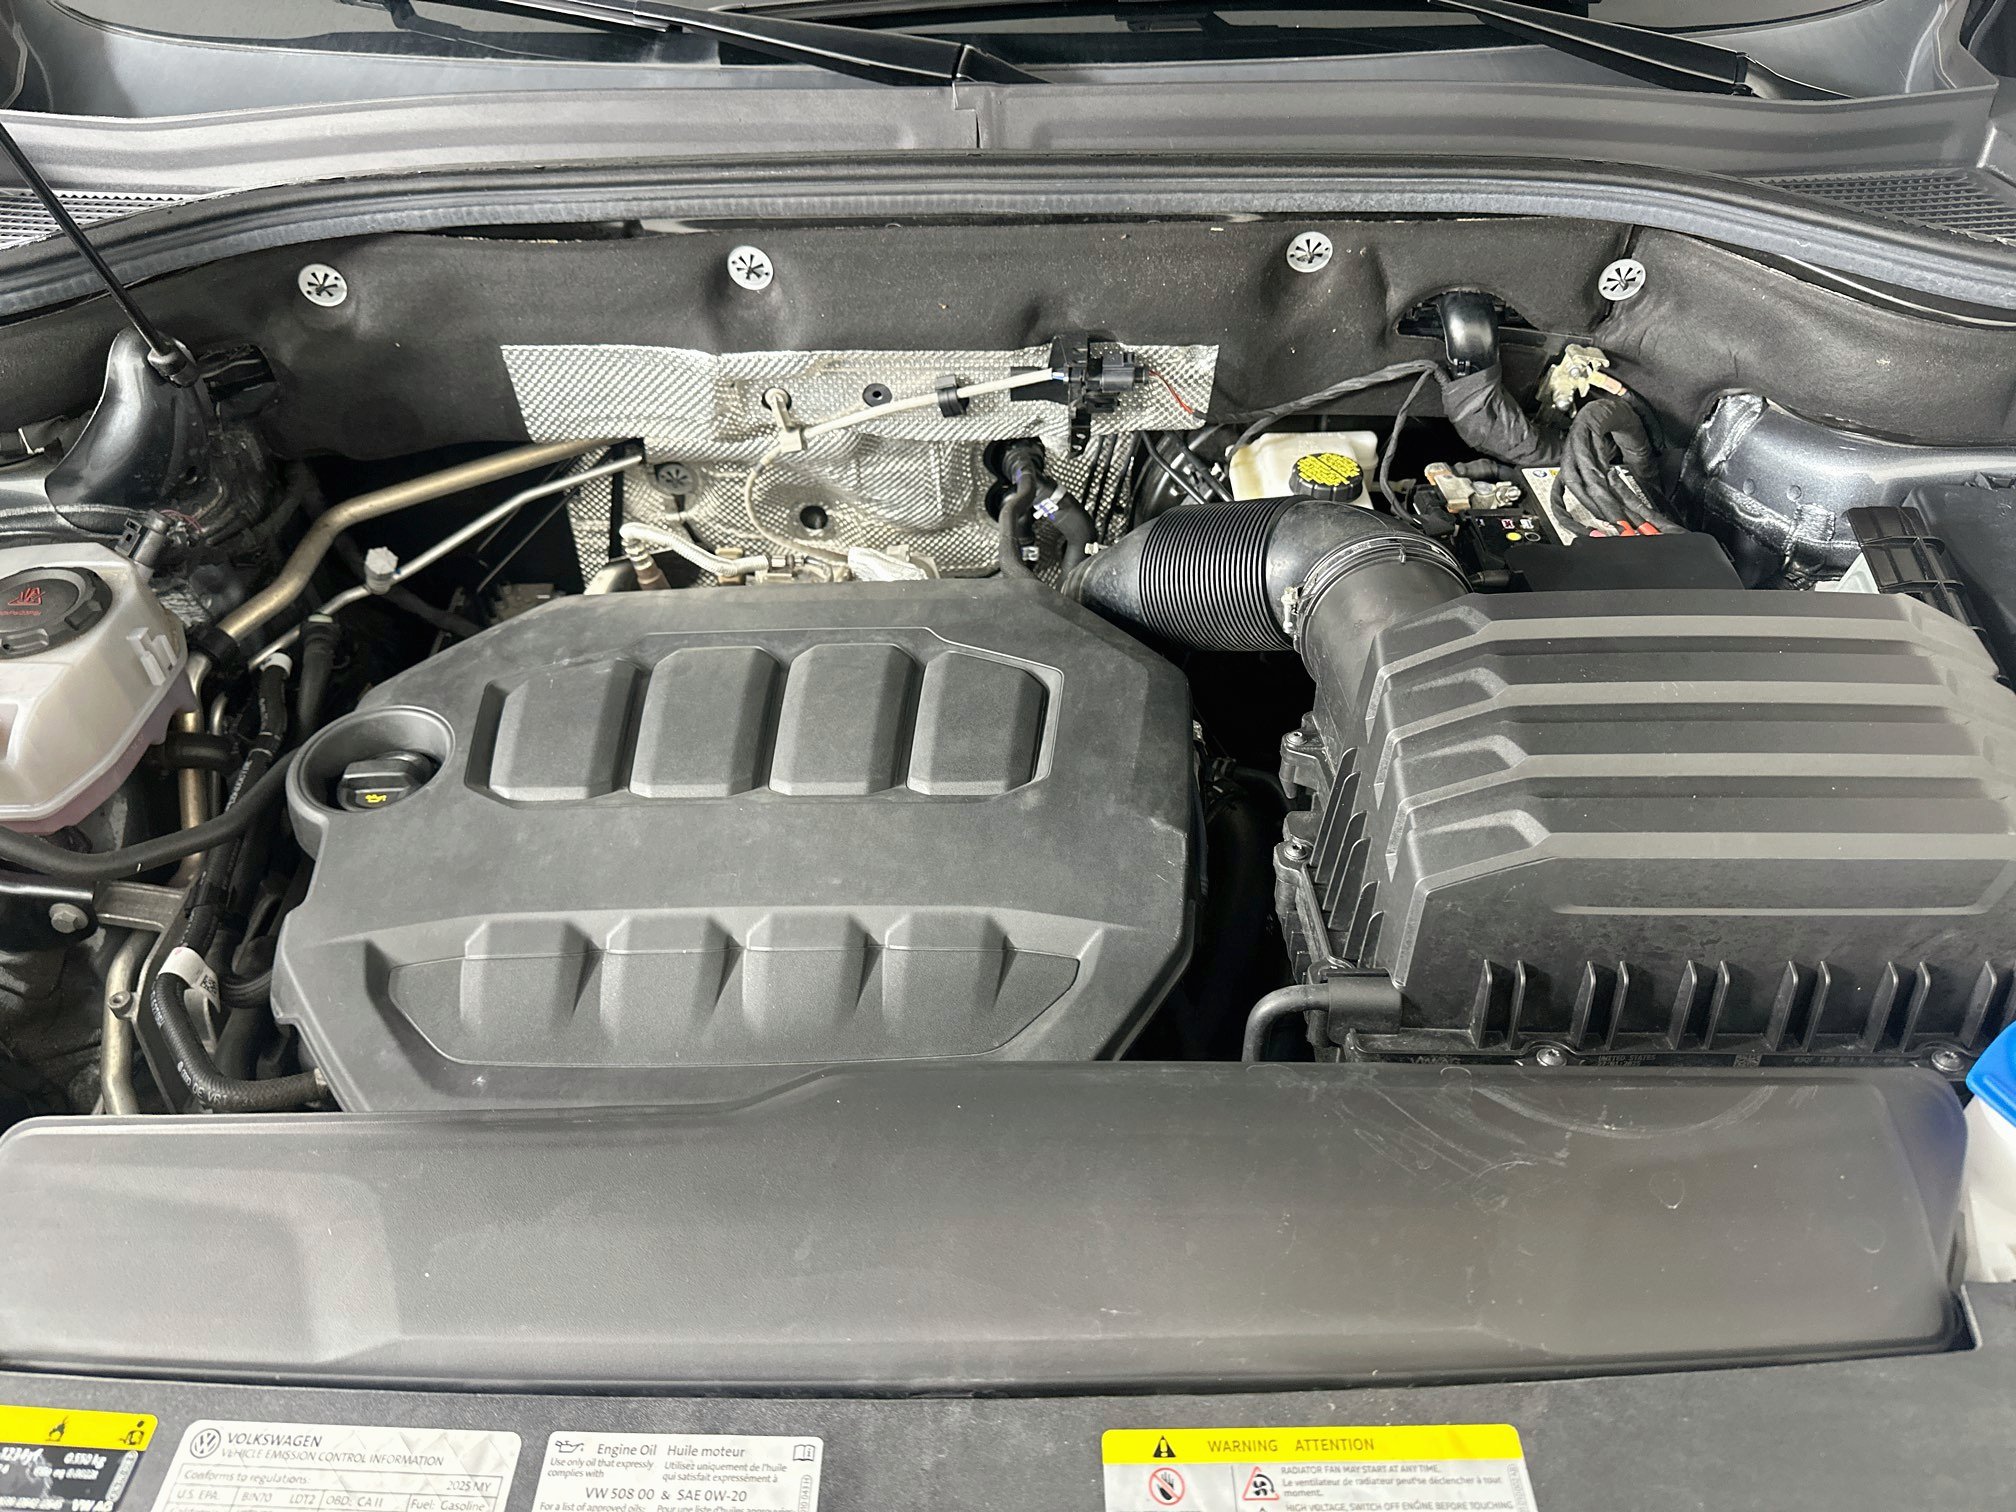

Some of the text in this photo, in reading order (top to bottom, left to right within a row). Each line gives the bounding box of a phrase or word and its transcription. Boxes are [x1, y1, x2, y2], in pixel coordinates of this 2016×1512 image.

[227, 1433, 323, 1448] VOLKSWAGEN
[1208, 1438, 1375, 1452] WARNING ATTENTION
[597, 1444, 657, 1458] Engine Oil
[667, 1445, 746, 1457] Huile moteur
[222, 1449, 444, 1466] VEHICLE EMISSION CONTROL INFORMATION
[550, 1458, 654, 1470] Use only oil that expressly
[664, 1461, 787, 1472] Utilisez uniquement de l'huile
[1280, 1466, 1321, 1474] RADIATOR
[1324, 1466, 1342, 1474] FAN
[1362, 1465, 1386, 1473] START
[184, 1469, 234, 1482] Conforms
[237, 1472, 247, 1482] to
[548, 1468, 604, 1479] complies with
[662, 1473, 676, 1482] qui
[677, 1472, 710, 1482] satisfait
[712, 1474, 770, 1484] expressément
[446, 1480, 492, 1492] 2025 MY
[1282, 1478, 1293, 1486] Le
[1295, 1478, 1340, 1486] ventilateur
[1342, 1478, 1353, 1486] de
[1430, 1476, 1474, 1484] déclencher
[1476, 1476, 1483, 1484] à
[1484, 1476, 1502, 1484] tout
[198, 1490, 218, 1500] EPA
[289, 1494, 316, 1504] LDT2
[586, 1487, 747, 1502] VW 508 00 & SAE 0W-20
[410, 1499, 486, 1512] Fuel: Gasoline
[540, 1502, 554, 1510] For
[562, 1502, 575, 1512] list
[576, 1502, 587, 1512] of
[587, 1503, 626, 1512] approved
[1286, 1503, 1307, 1512] HIGH
[1350, 1502, 1382, 1510] SWITCH
[1384, 1502, 1400, 1510] OFF
[1402, 1501, 1434, 1510] ENGINE
[1436, 1501, 1468, 1510] BEFORE
[1470, 1501, 1514, 1510] TOUCHING
